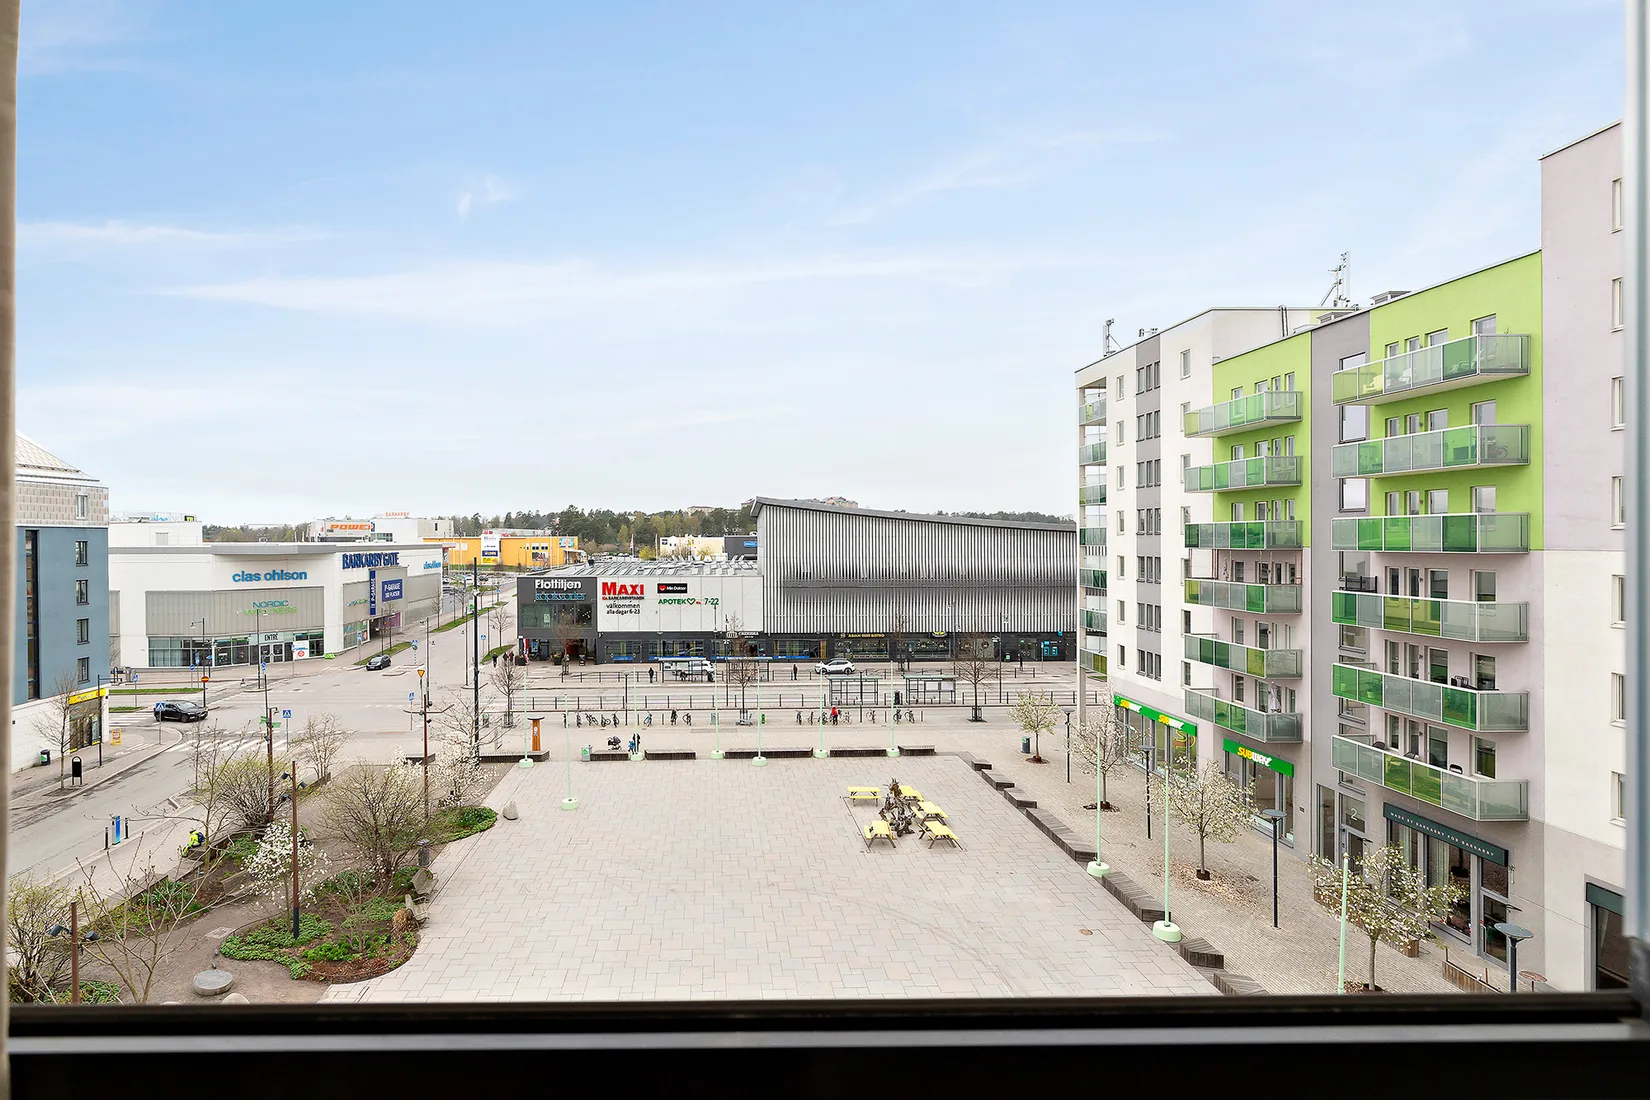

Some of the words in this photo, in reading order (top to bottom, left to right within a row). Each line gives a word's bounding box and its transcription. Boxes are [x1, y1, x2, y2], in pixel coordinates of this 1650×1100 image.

[342, 553, 382, 569] BARKARBY
[383, 552, 400, 566] GATE
[232, 570, 261, 583] clas
[264, 569, 308, 581] ohlson
[535, 579, 582, 591] Flottiljen
[252, 600, 289, 608] NORDIC
[1120, 699, 1142, 713] SUBWAY
[1158, 714, 1184, 730] SUBWAY
[1237, 746, 1272, 767] SUBWAY
